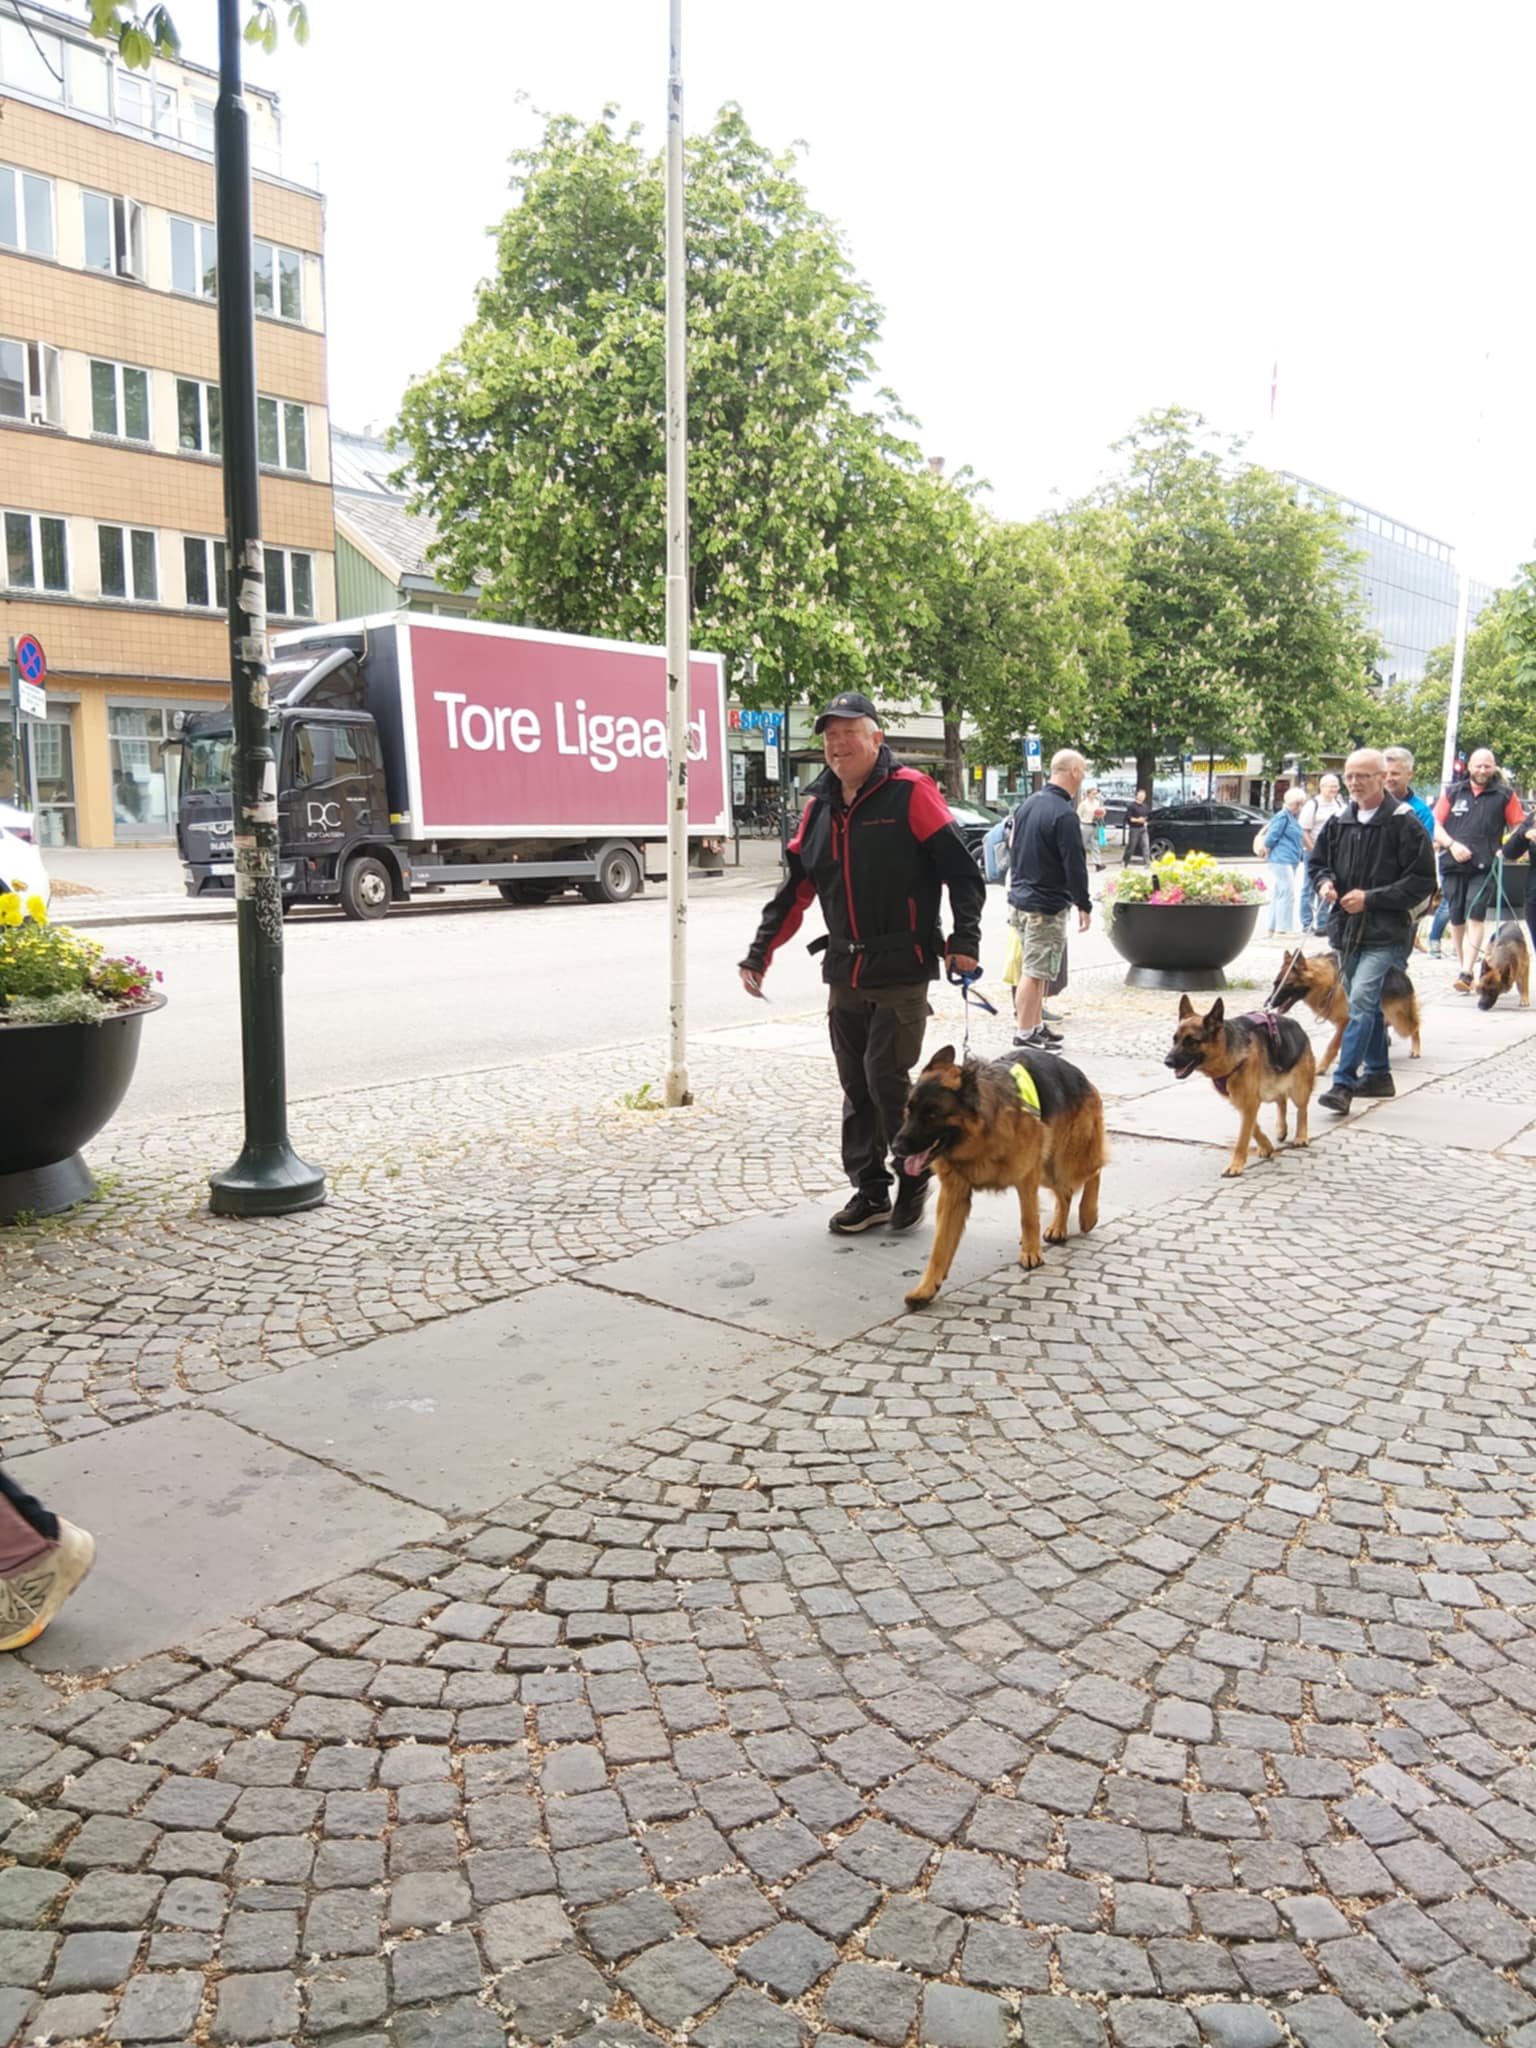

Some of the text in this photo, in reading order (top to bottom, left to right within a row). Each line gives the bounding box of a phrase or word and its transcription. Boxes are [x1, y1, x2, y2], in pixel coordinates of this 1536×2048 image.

[433, 691, 542, 753] Tore
[554, 699, 708, 772] Ligaad
[767, 728, 775, 744] P
[1029, 742, 1037, 754] P
